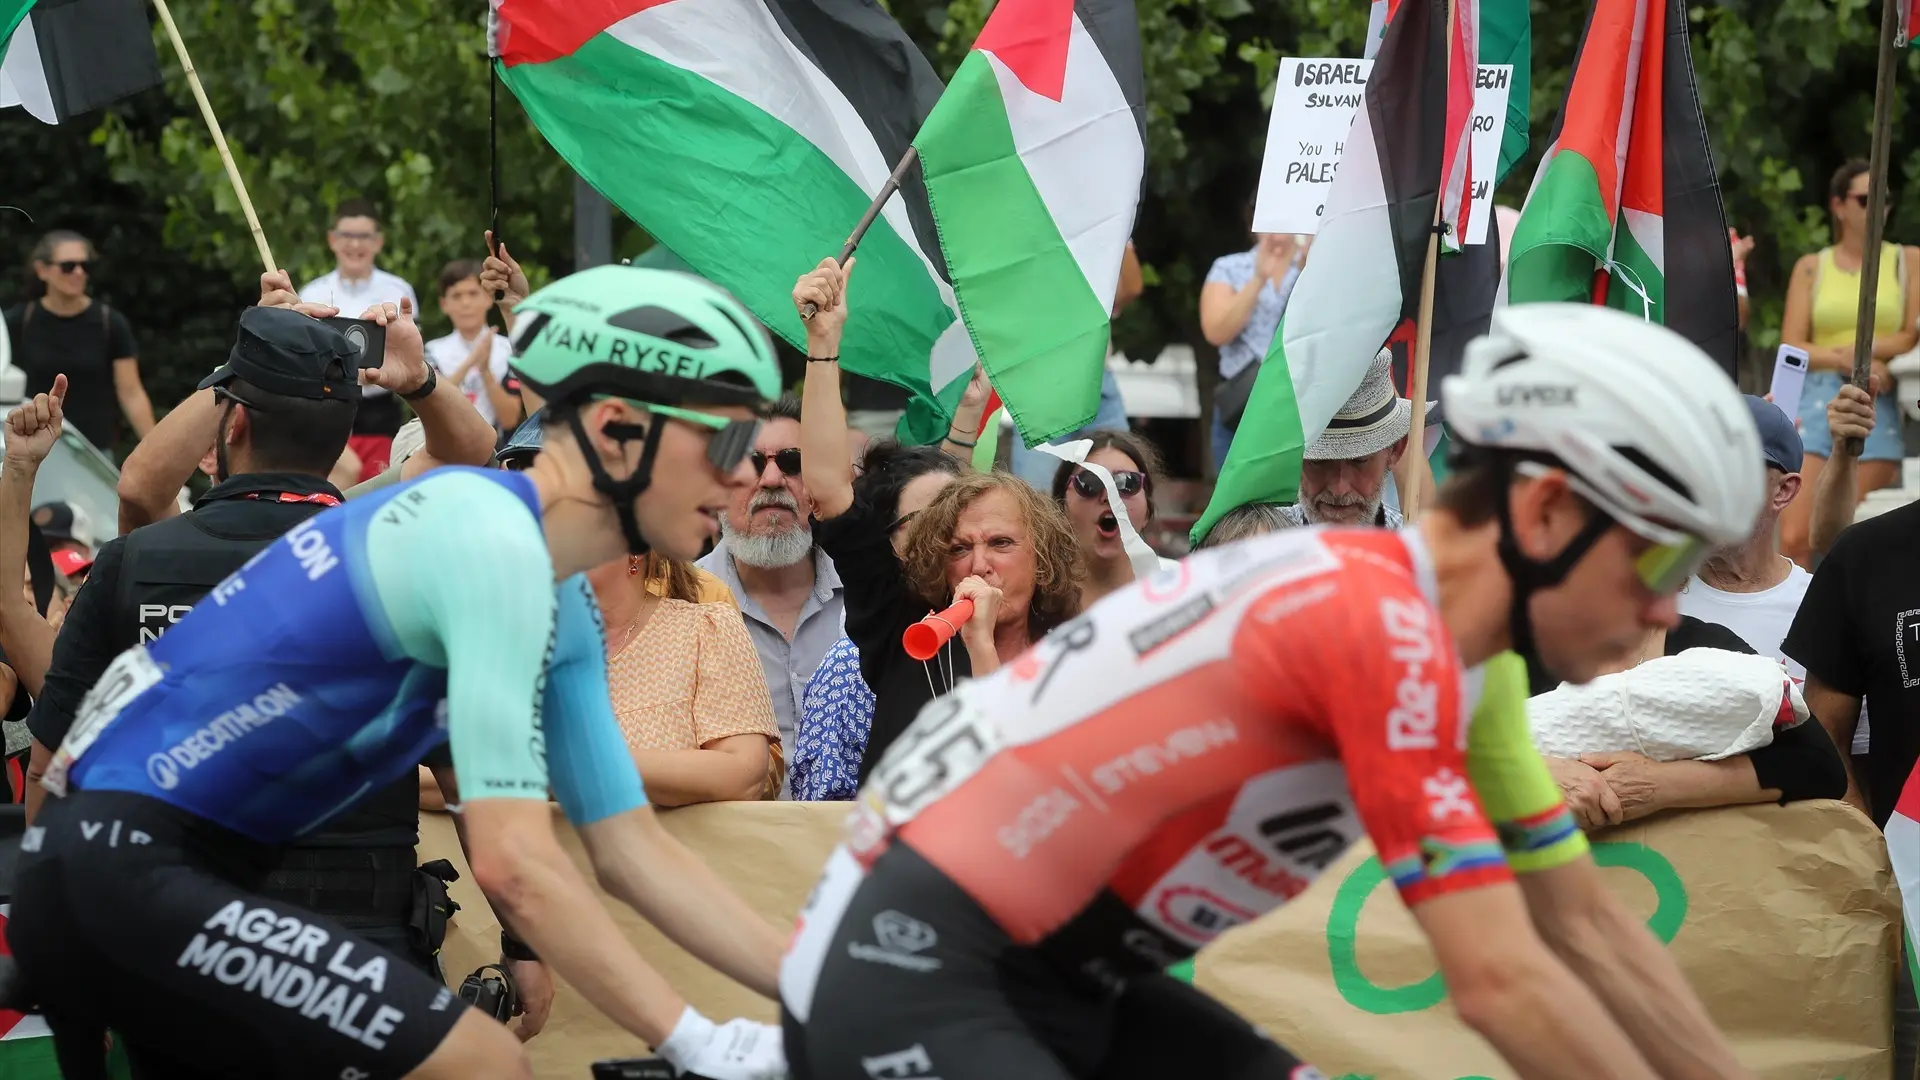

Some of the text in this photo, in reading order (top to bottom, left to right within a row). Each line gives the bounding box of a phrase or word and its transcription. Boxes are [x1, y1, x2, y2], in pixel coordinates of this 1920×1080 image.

[1294, 62, 1508, 89] ISRAEL ECH
[1305, 92, 1362, 108] SYLVAN
[1472, 115, 1494, 132] RO
[1299, 141, 1323, 156] YOU
[1471, 180, 1488, 200] EN
[542, 323, 600, 356] VAN
[285, 516, 340, 581] LON
[176, 681, 305, 772] DECATHLON
[203, 899, 389, 993] AG2R LA
[176, 932, 406, 1052] MONDIALE
